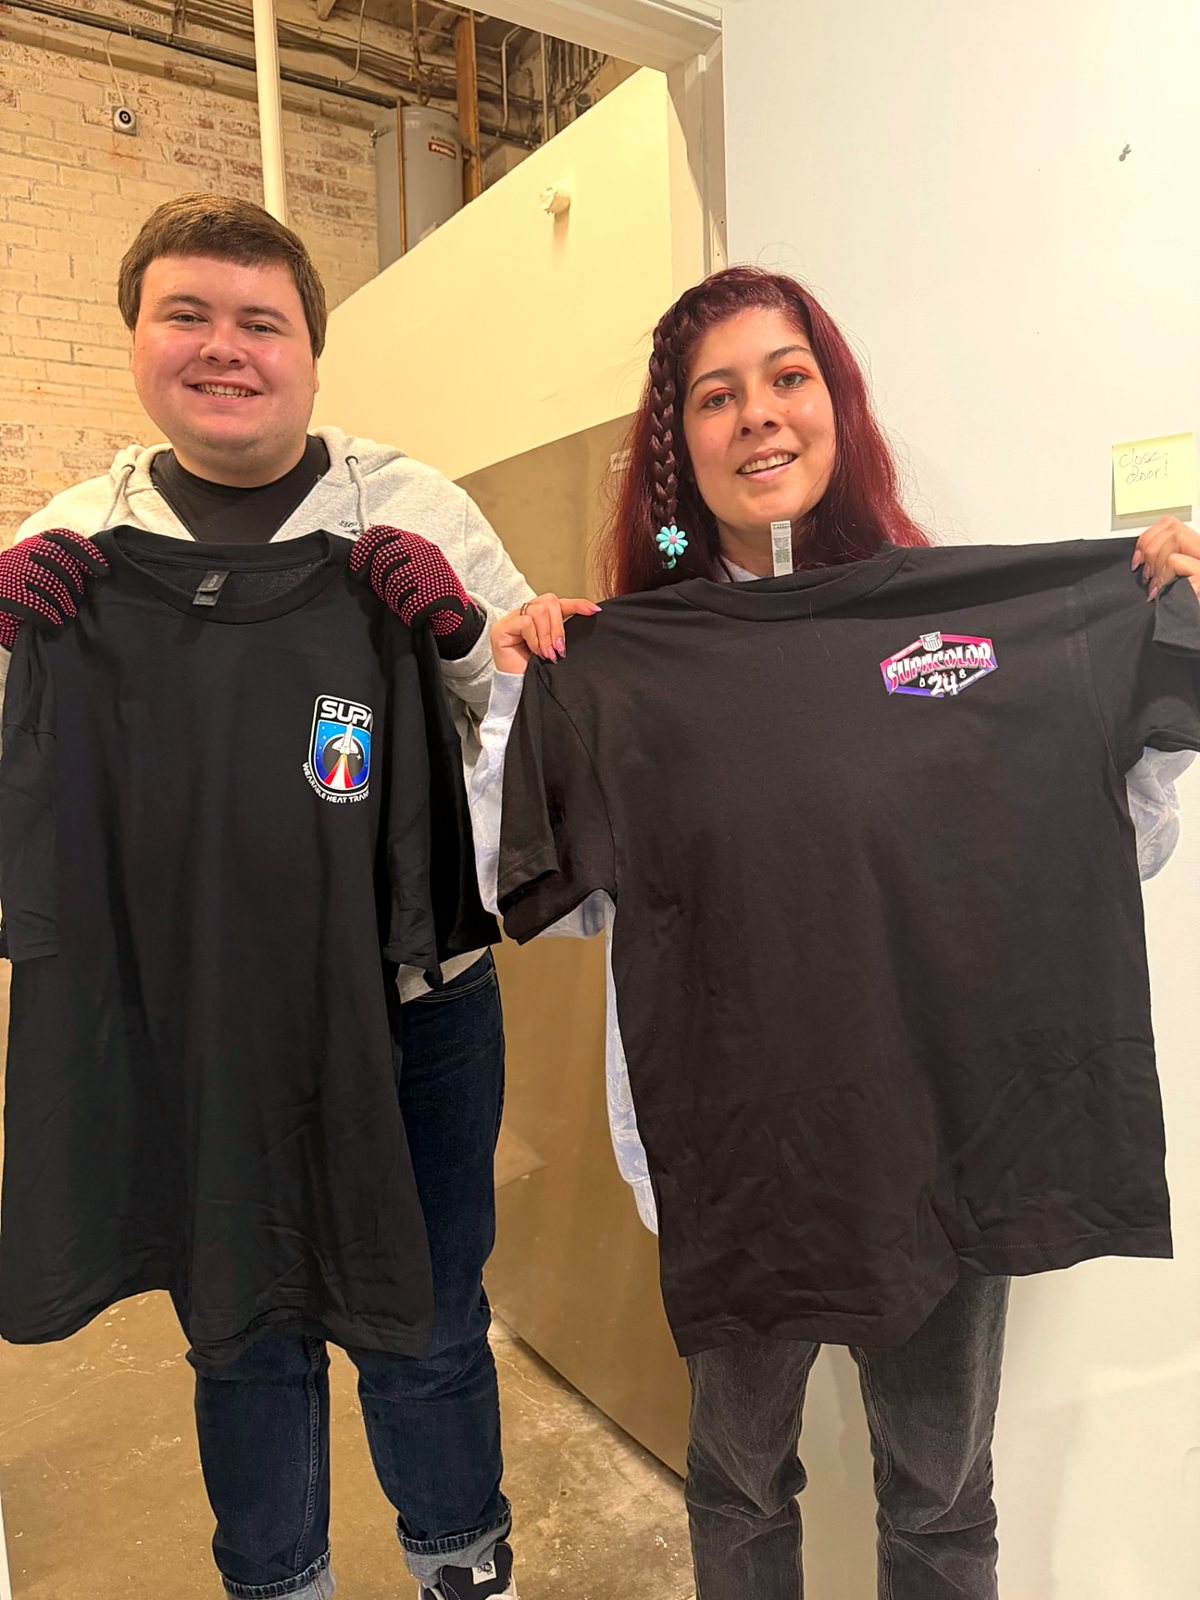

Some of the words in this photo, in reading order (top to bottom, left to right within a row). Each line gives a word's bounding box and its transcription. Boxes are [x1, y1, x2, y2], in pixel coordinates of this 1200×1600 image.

[887, 642, 994, 694] SUPACOLOR
[927, 671, 959, 696] 24
[326, 795, 347, 804] HEAT
